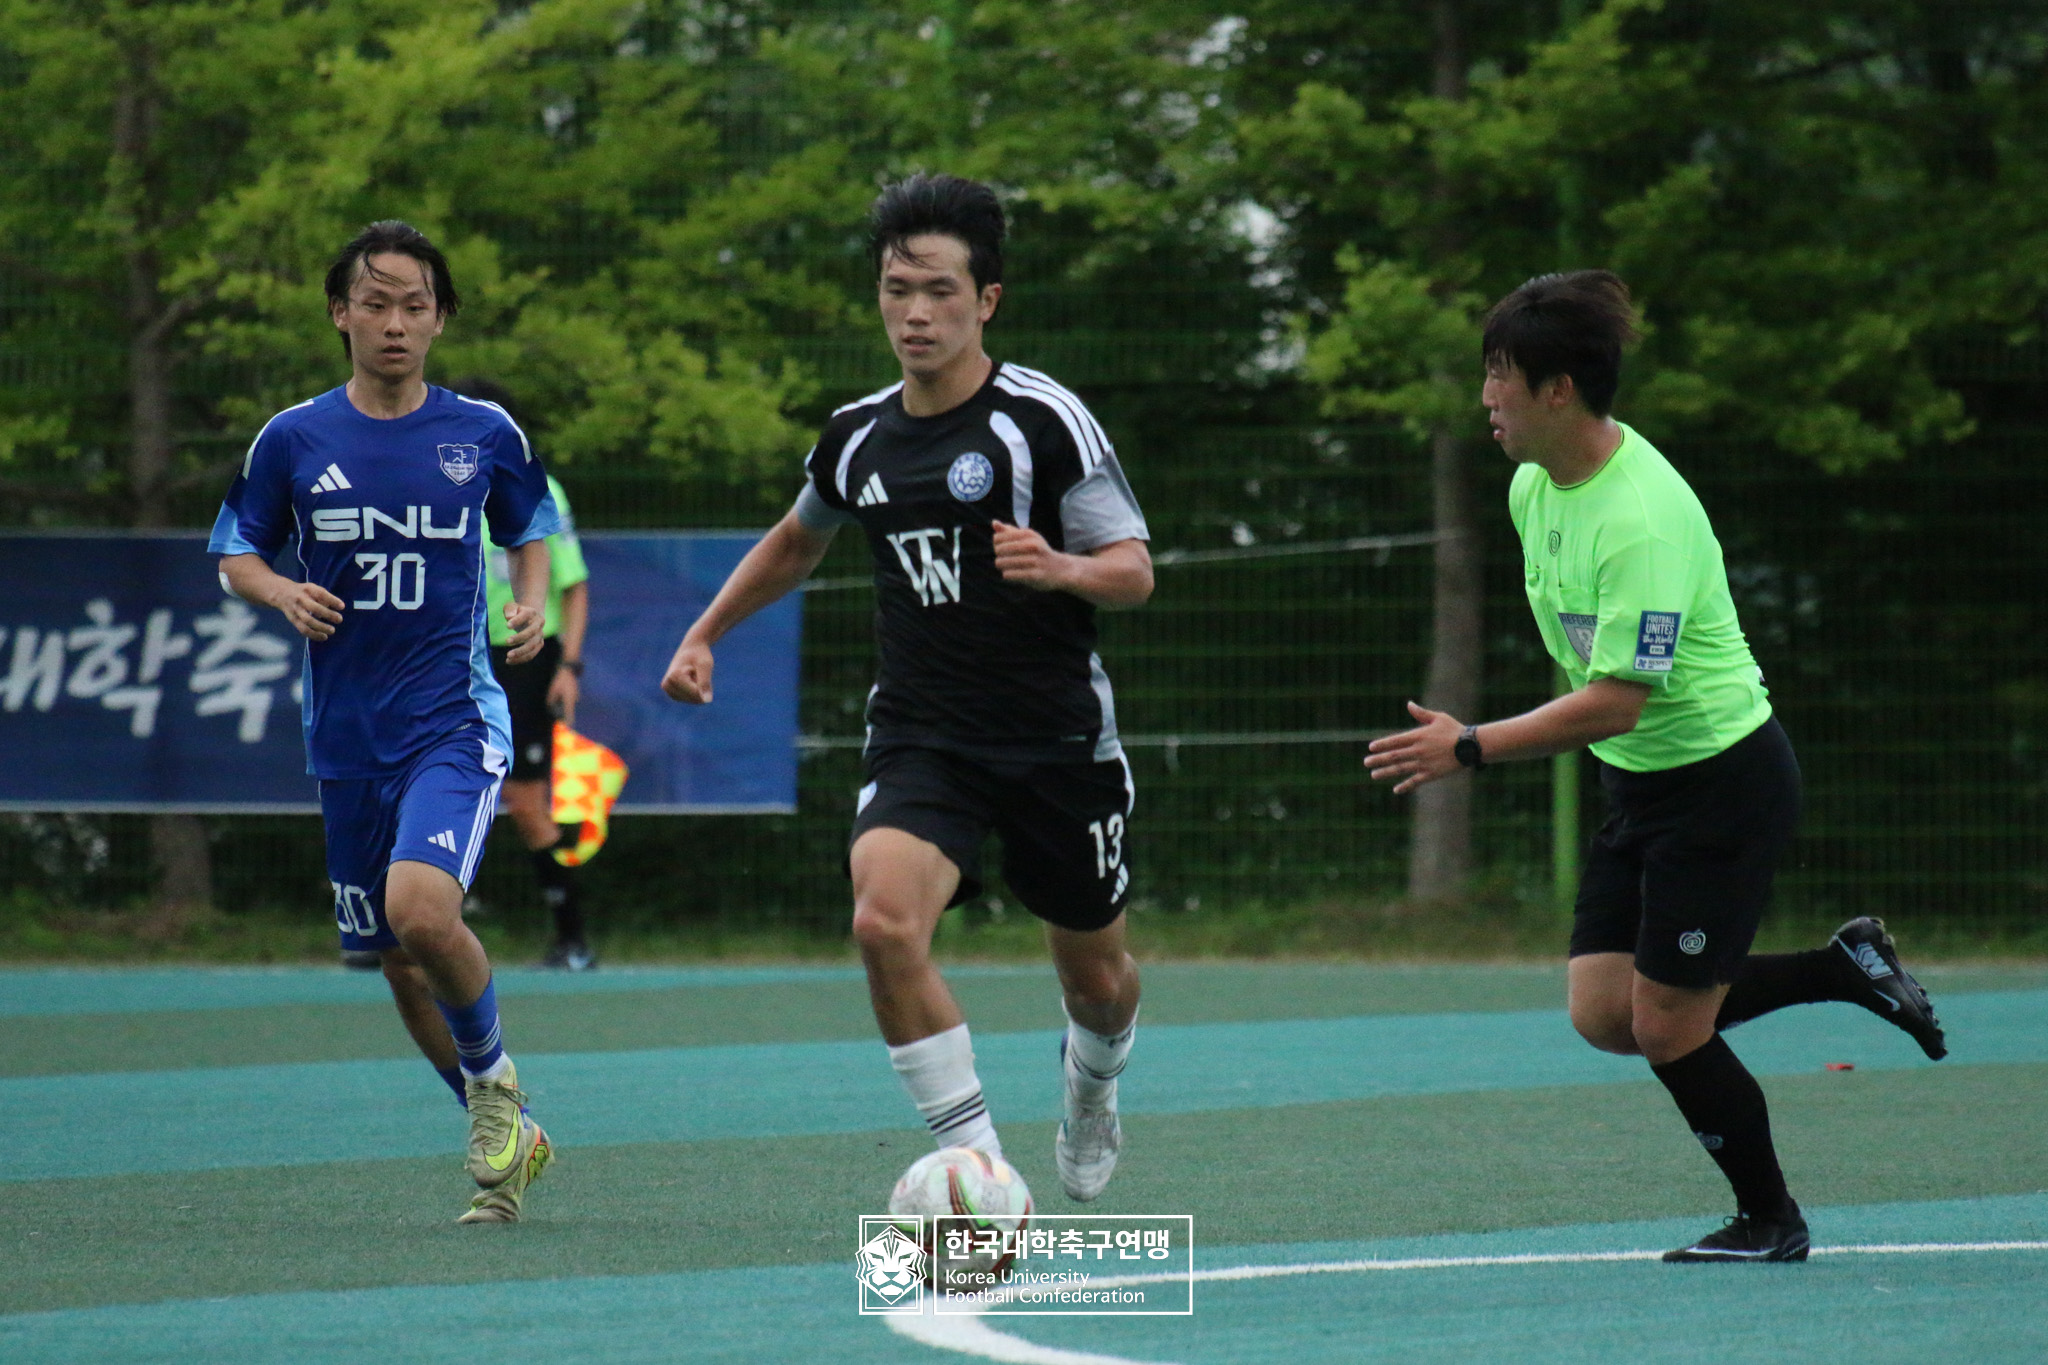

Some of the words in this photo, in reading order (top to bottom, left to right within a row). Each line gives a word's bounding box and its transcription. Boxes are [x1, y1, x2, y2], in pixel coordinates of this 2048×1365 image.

[313, 505, 470, 542] SNU
[353, 552, 426, 611] 30
[1645, 623, 1674, 635] UNITES
[1647, 614, 1675, 624] FOOTBALL
[1089, 813, 1126, 878] 13
